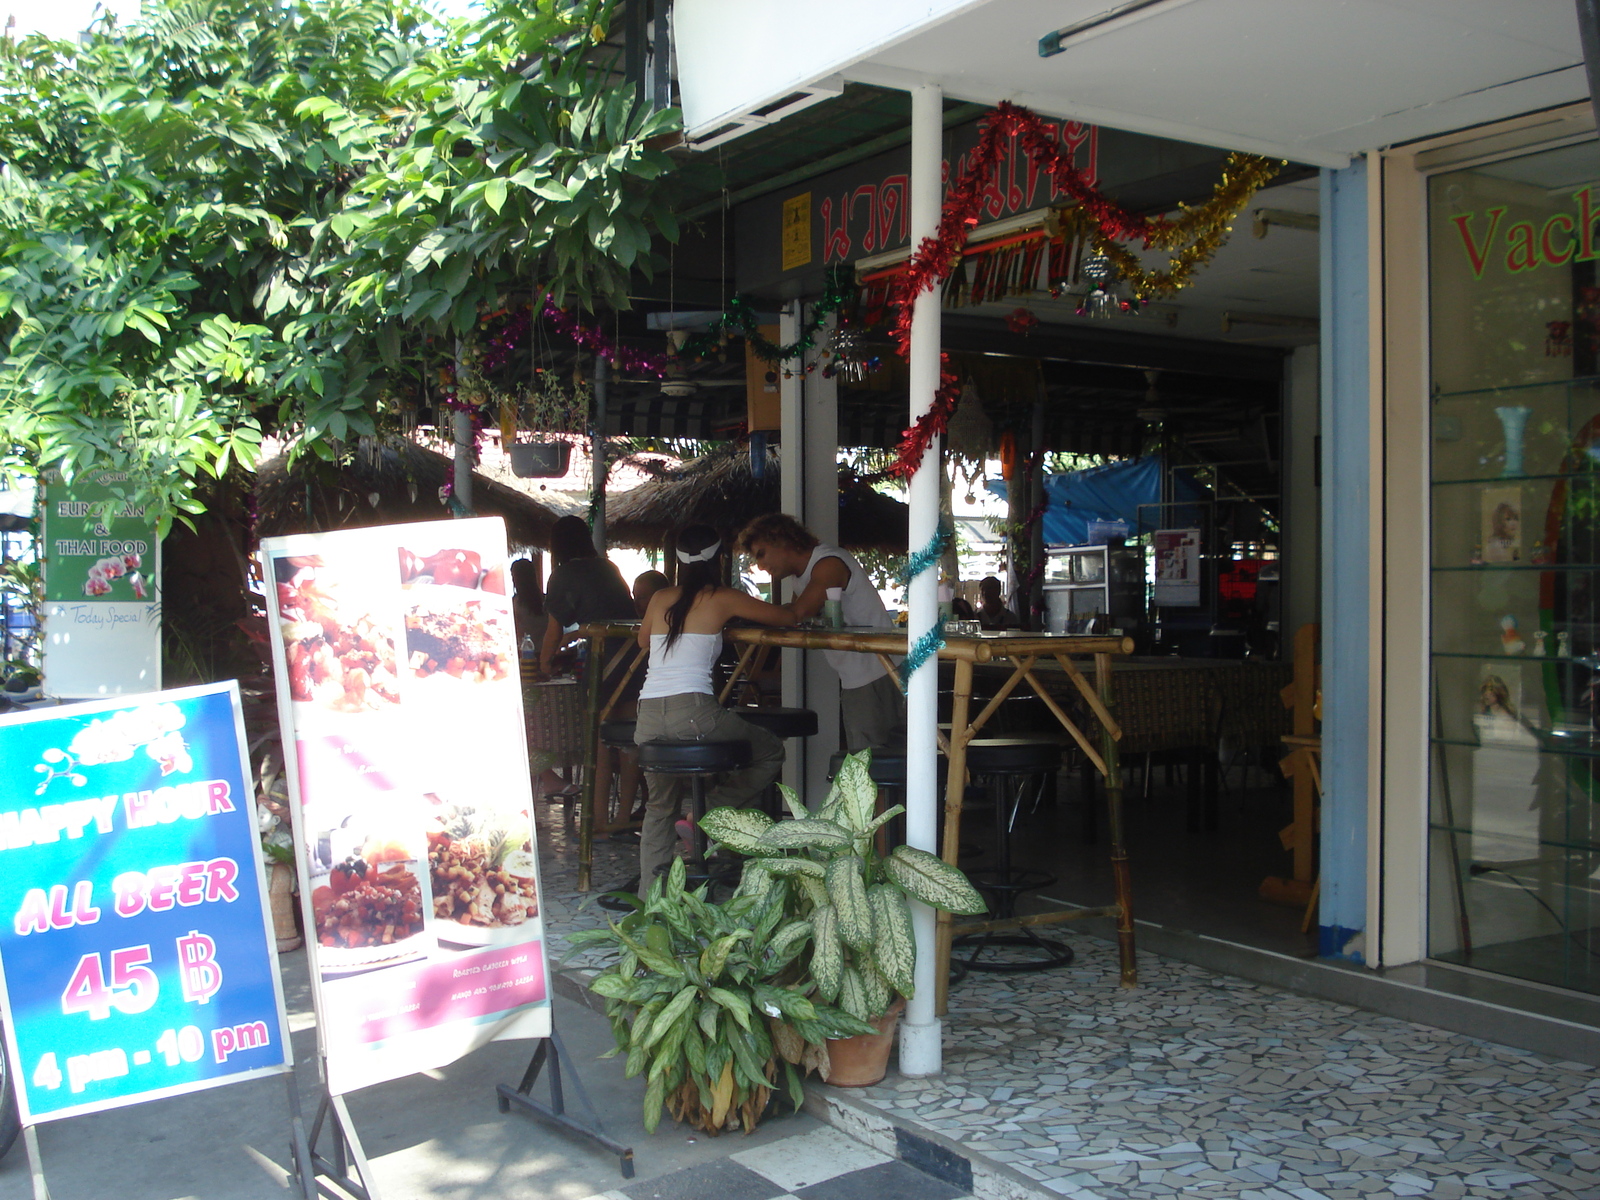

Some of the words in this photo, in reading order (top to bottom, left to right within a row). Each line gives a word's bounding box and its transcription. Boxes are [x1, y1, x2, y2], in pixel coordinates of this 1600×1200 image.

[55, 540, 97, 556] THAI
[100, 540, 148, 556] FOOD
[94, 523, 112, 537] &
[70, 605, 104, 629] Today
[105, 606, 141, 630] Special
[0, 795, 118, 850] HAPPY
[123, 779, 236, 829] HOUR
[15, 880, 100, 935] ALL
[112, 858, 240, 917] BEER
[62, 944, 160, 1020] 45
[33, 1052, 63, 1090] 4
[66, 1047, 129, 1093] pm
[156, 1025, 204, 1066] 10
[211, 1021, 270, 1063] pm
